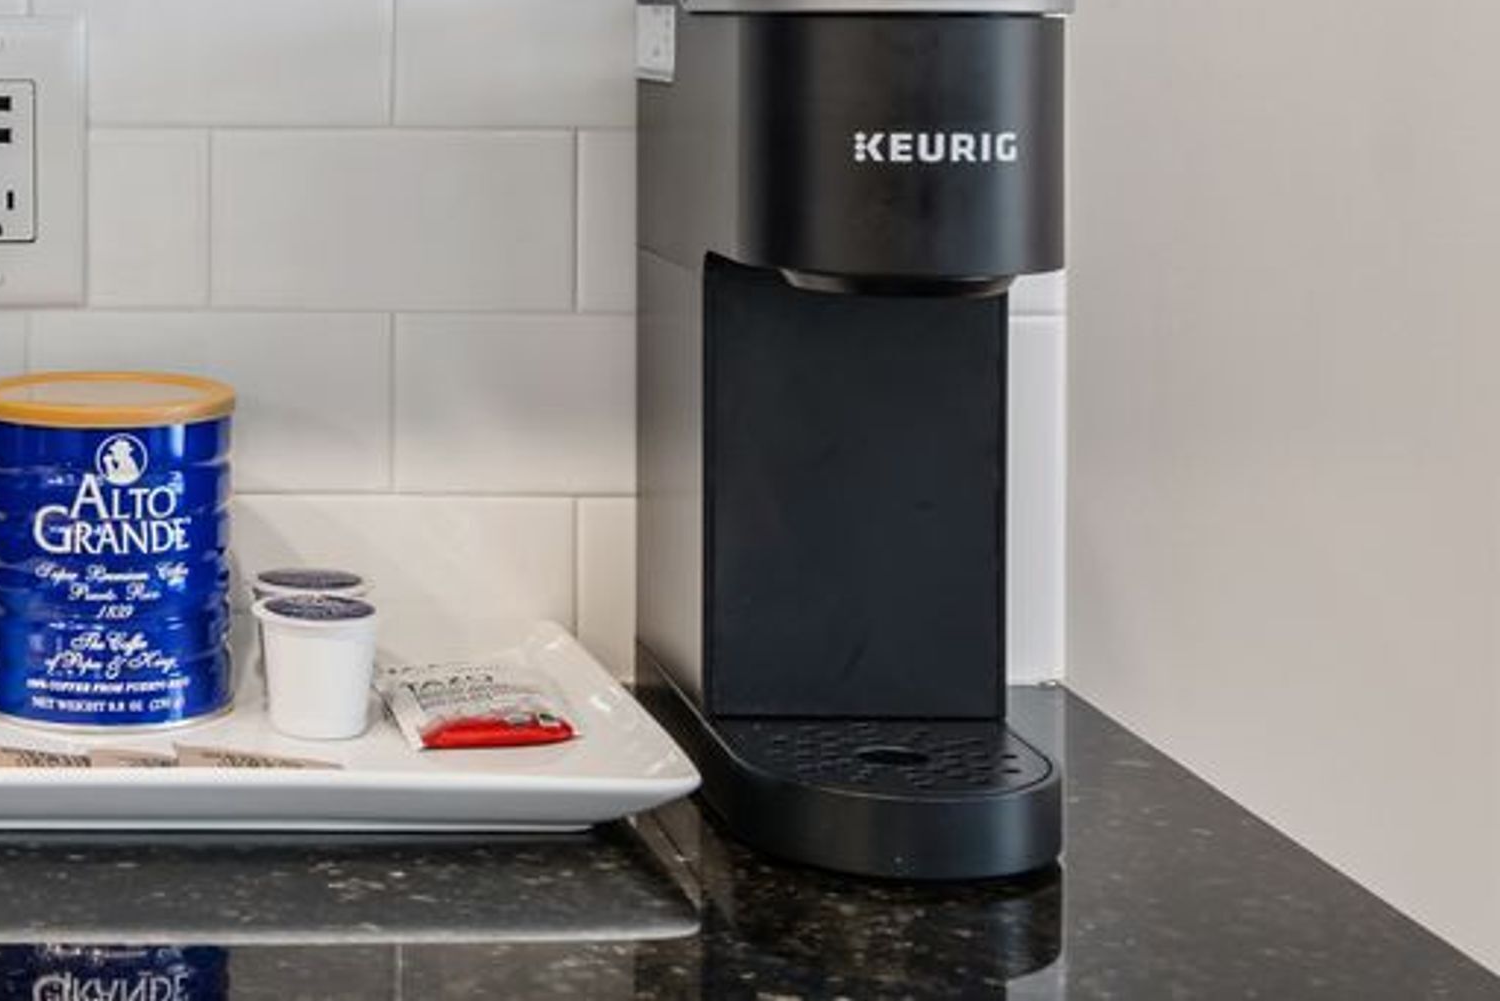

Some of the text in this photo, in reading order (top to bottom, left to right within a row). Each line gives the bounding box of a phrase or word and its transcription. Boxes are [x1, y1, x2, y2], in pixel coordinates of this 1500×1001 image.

[854, 131, 1018, 163] KEURIG
[69, 473, 178, 519] ALTO
[32, 506, 190, 553] GRANDE
[70, 632, 105, 650] The
[56, 699, 105, 712] WEIGHT
